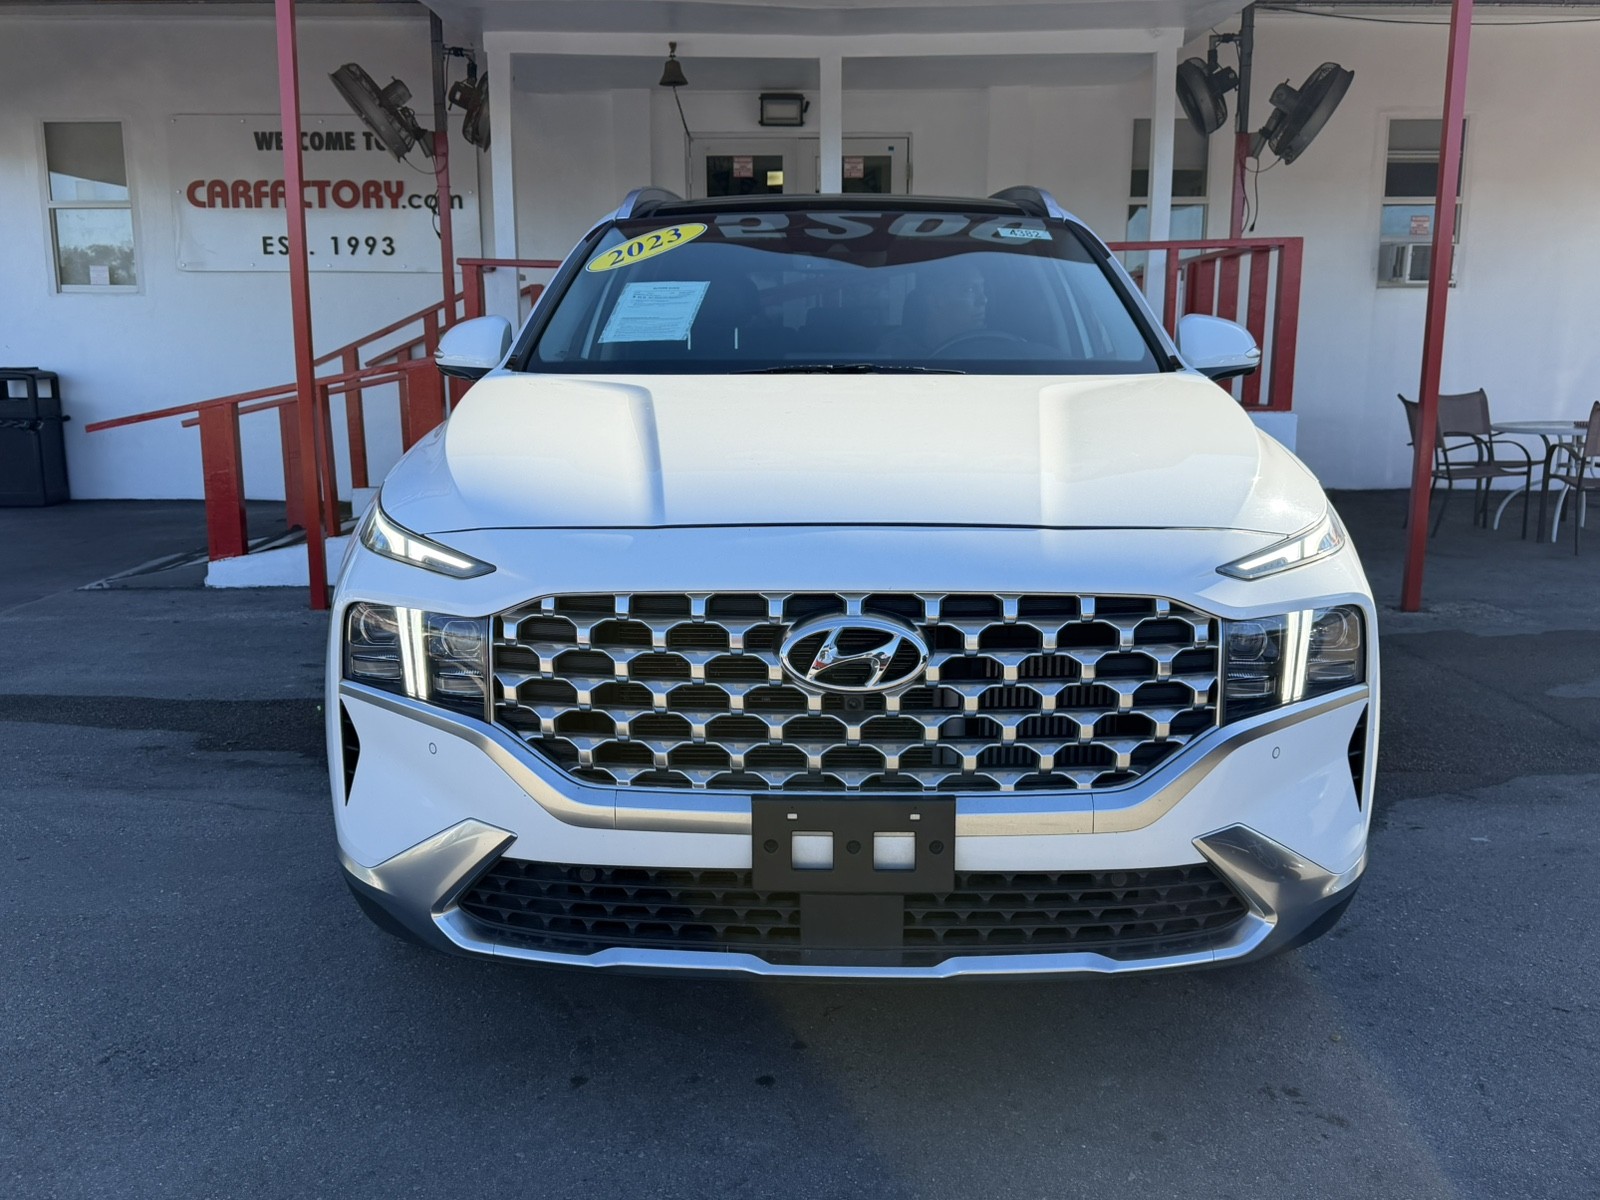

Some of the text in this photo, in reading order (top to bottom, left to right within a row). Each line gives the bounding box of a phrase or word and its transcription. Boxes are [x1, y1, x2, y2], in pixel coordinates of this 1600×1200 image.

[254, 131, 356, 151] WECOME
[1009, 229, 1041, 238] 4382
[262, 236, 396, 256] ES. 1993
[608, 227, 683, 267] 2023
